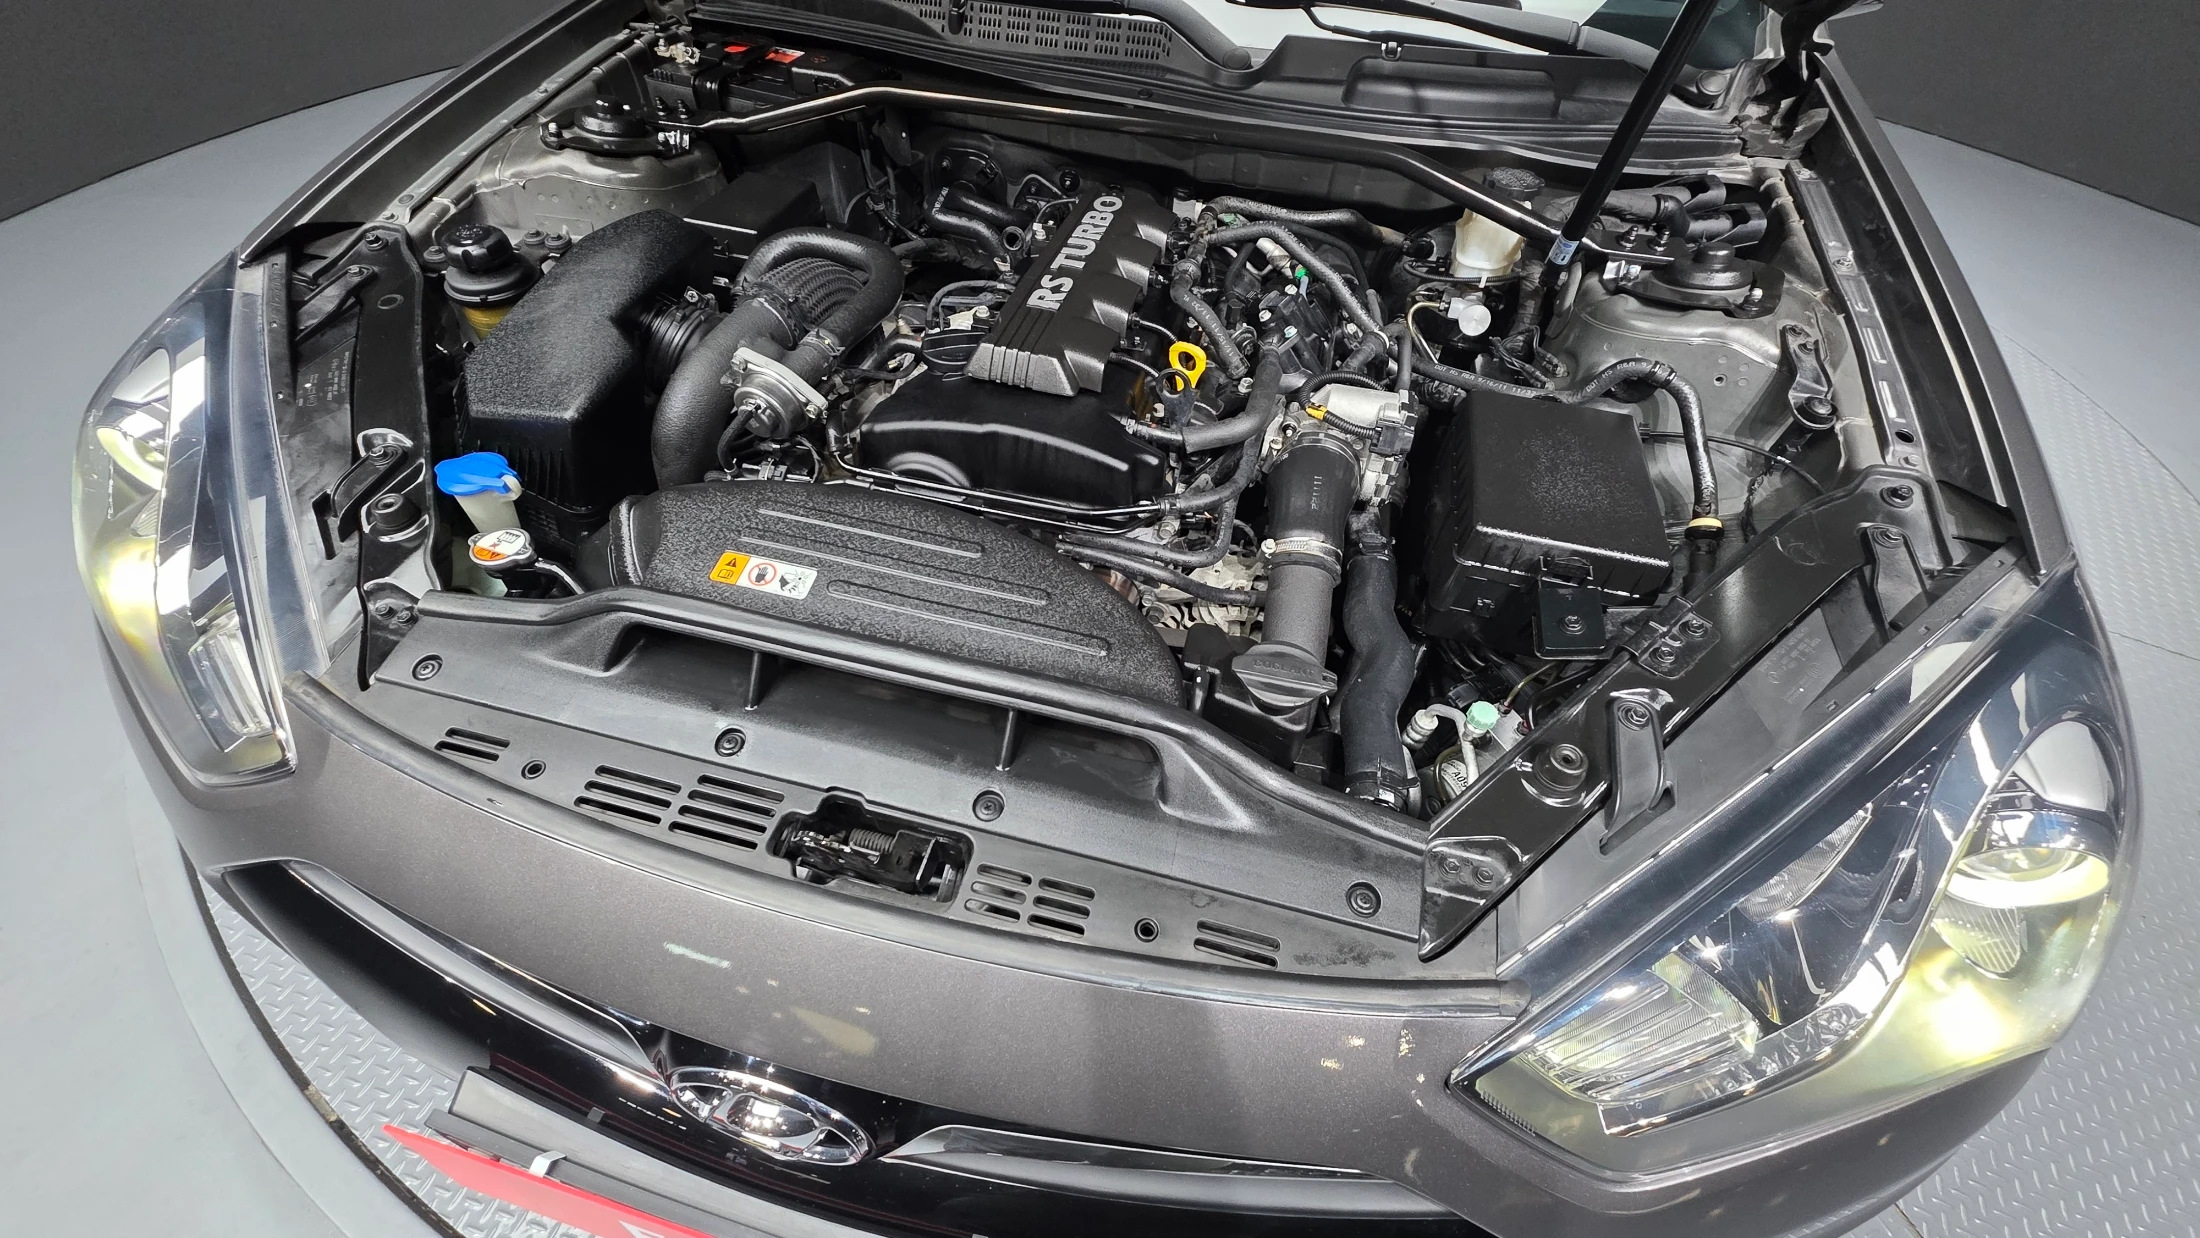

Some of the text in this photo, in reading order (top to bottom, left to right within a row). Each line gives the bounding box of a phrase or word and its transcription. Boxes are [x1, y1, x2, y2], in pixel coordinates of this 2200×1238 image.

[1026, 196, 1123, 312] RS TURBO
[1211, 323, 1234, 357] 11/15/11
[1434, 364, 1447, 372] DOT
[1585, 379, 1599, 393] DOT
[1601, 369, 1613, 379] HS
